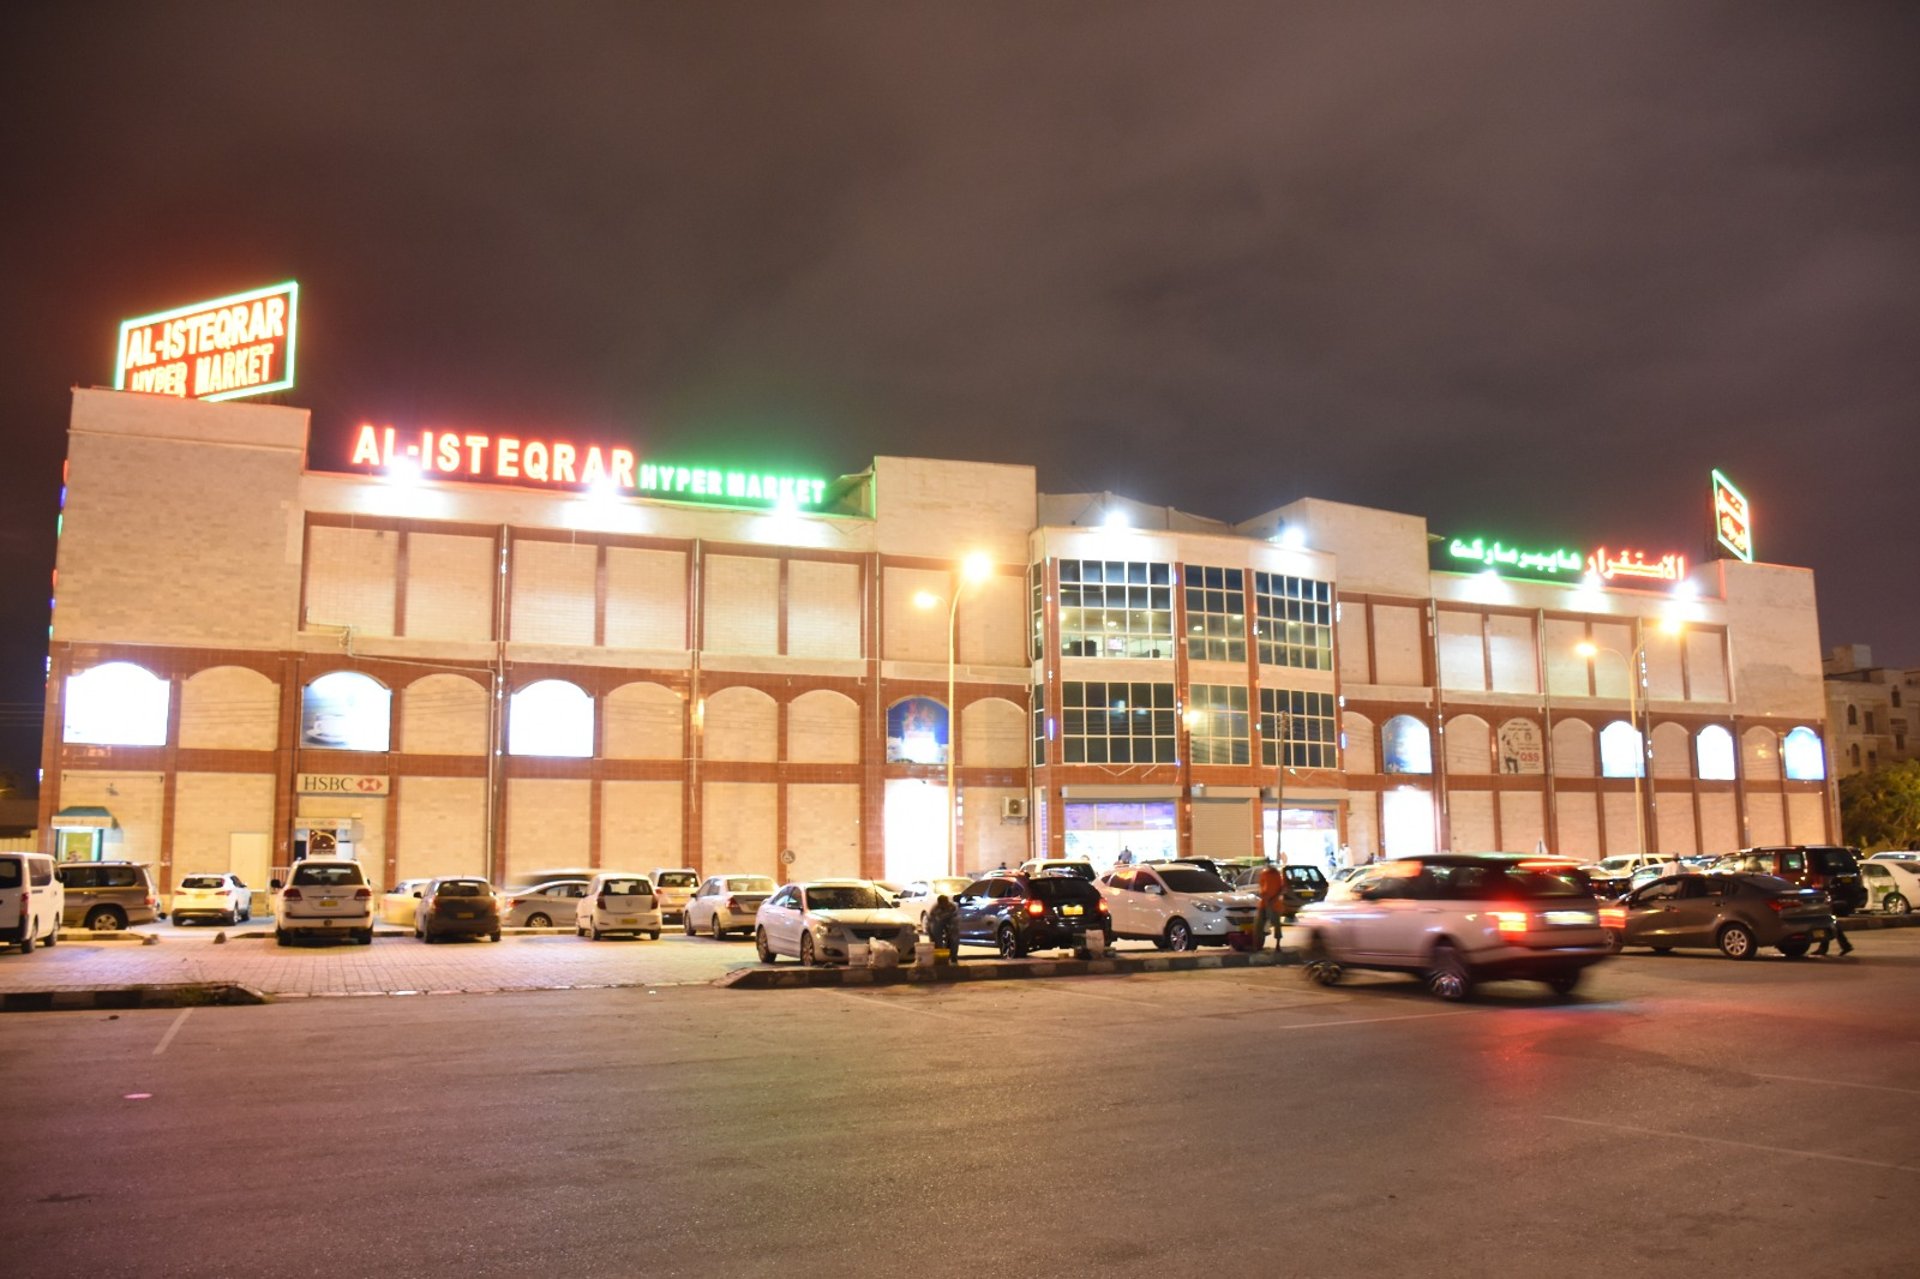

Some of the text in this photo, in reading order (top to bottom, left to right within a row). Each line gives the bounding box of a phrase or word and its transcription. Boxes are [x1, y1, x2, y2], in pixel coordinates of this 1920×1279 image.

[126, 298, 285, 369] AL-ISTEQRAR
[195, 343, 274, 395] MARKET
[352, 425, 635, 487] AL-ISTEQRAR
[640, 463, 826, 504] HYPER MARKET
[304, 776, 354, 791] HSBC
